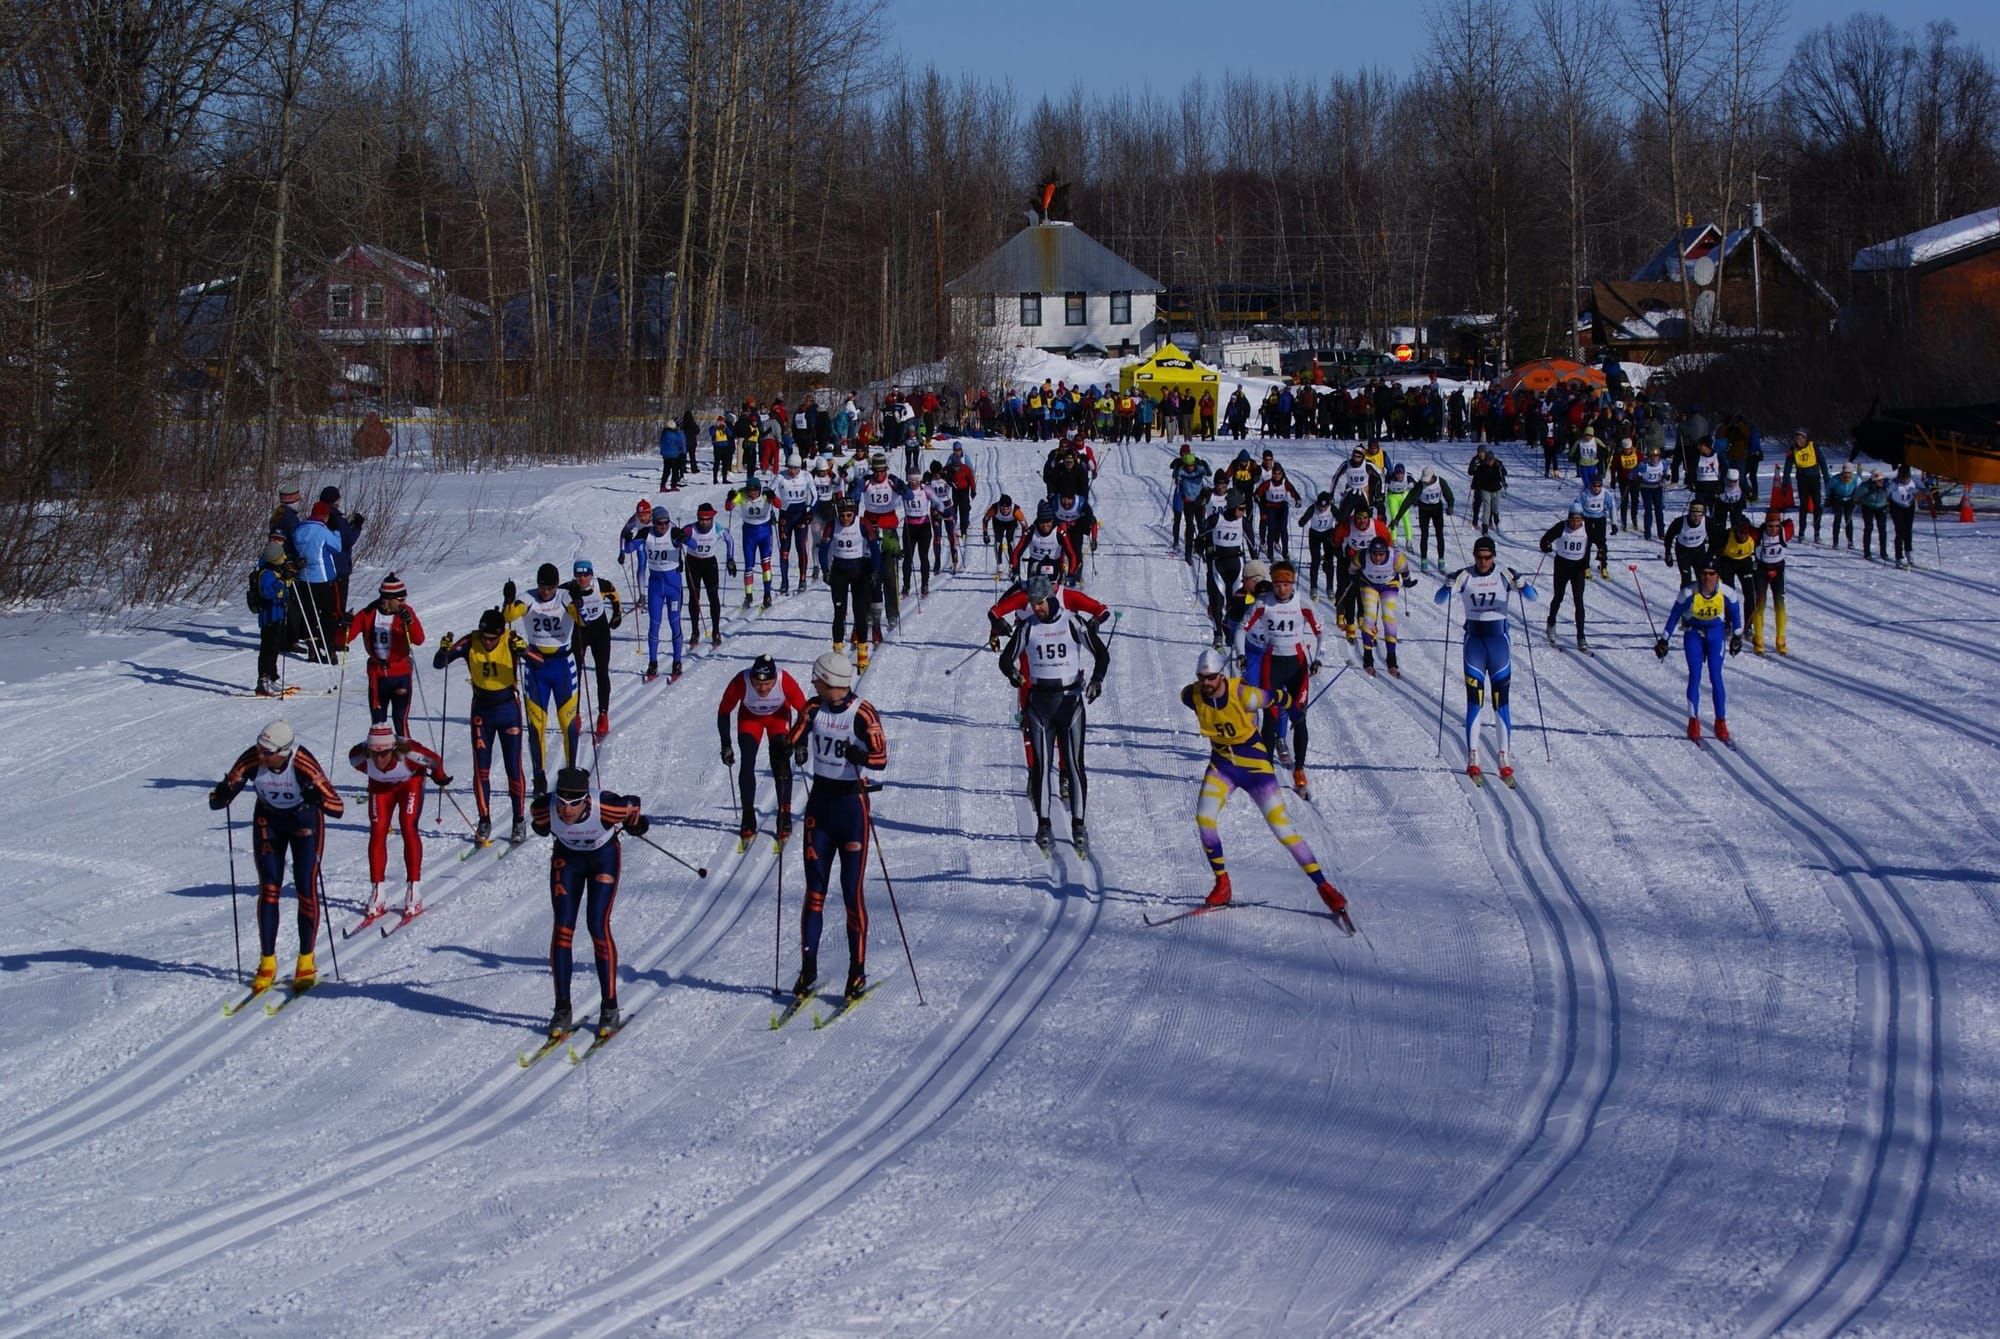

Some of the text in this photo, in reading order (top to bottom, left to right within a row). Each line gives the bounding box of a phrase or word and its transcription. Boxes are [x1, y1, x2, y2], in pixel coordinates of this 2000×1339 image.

[870, 494, 889, 503] 129
[1217, 530, 1238, 541] 147
[1563, 540, 1582, 551] 180
[648, 549, 668, 561] 270
[1469, 592, 1496, 607] 177
[532, 616, 562, 632] 292
[1267, 619, 1294, 632] 241
[1036, 643, 1067, 660] 159
[482, 661, 498, 677] 51
[1215, 722, 1236, 738] 50
